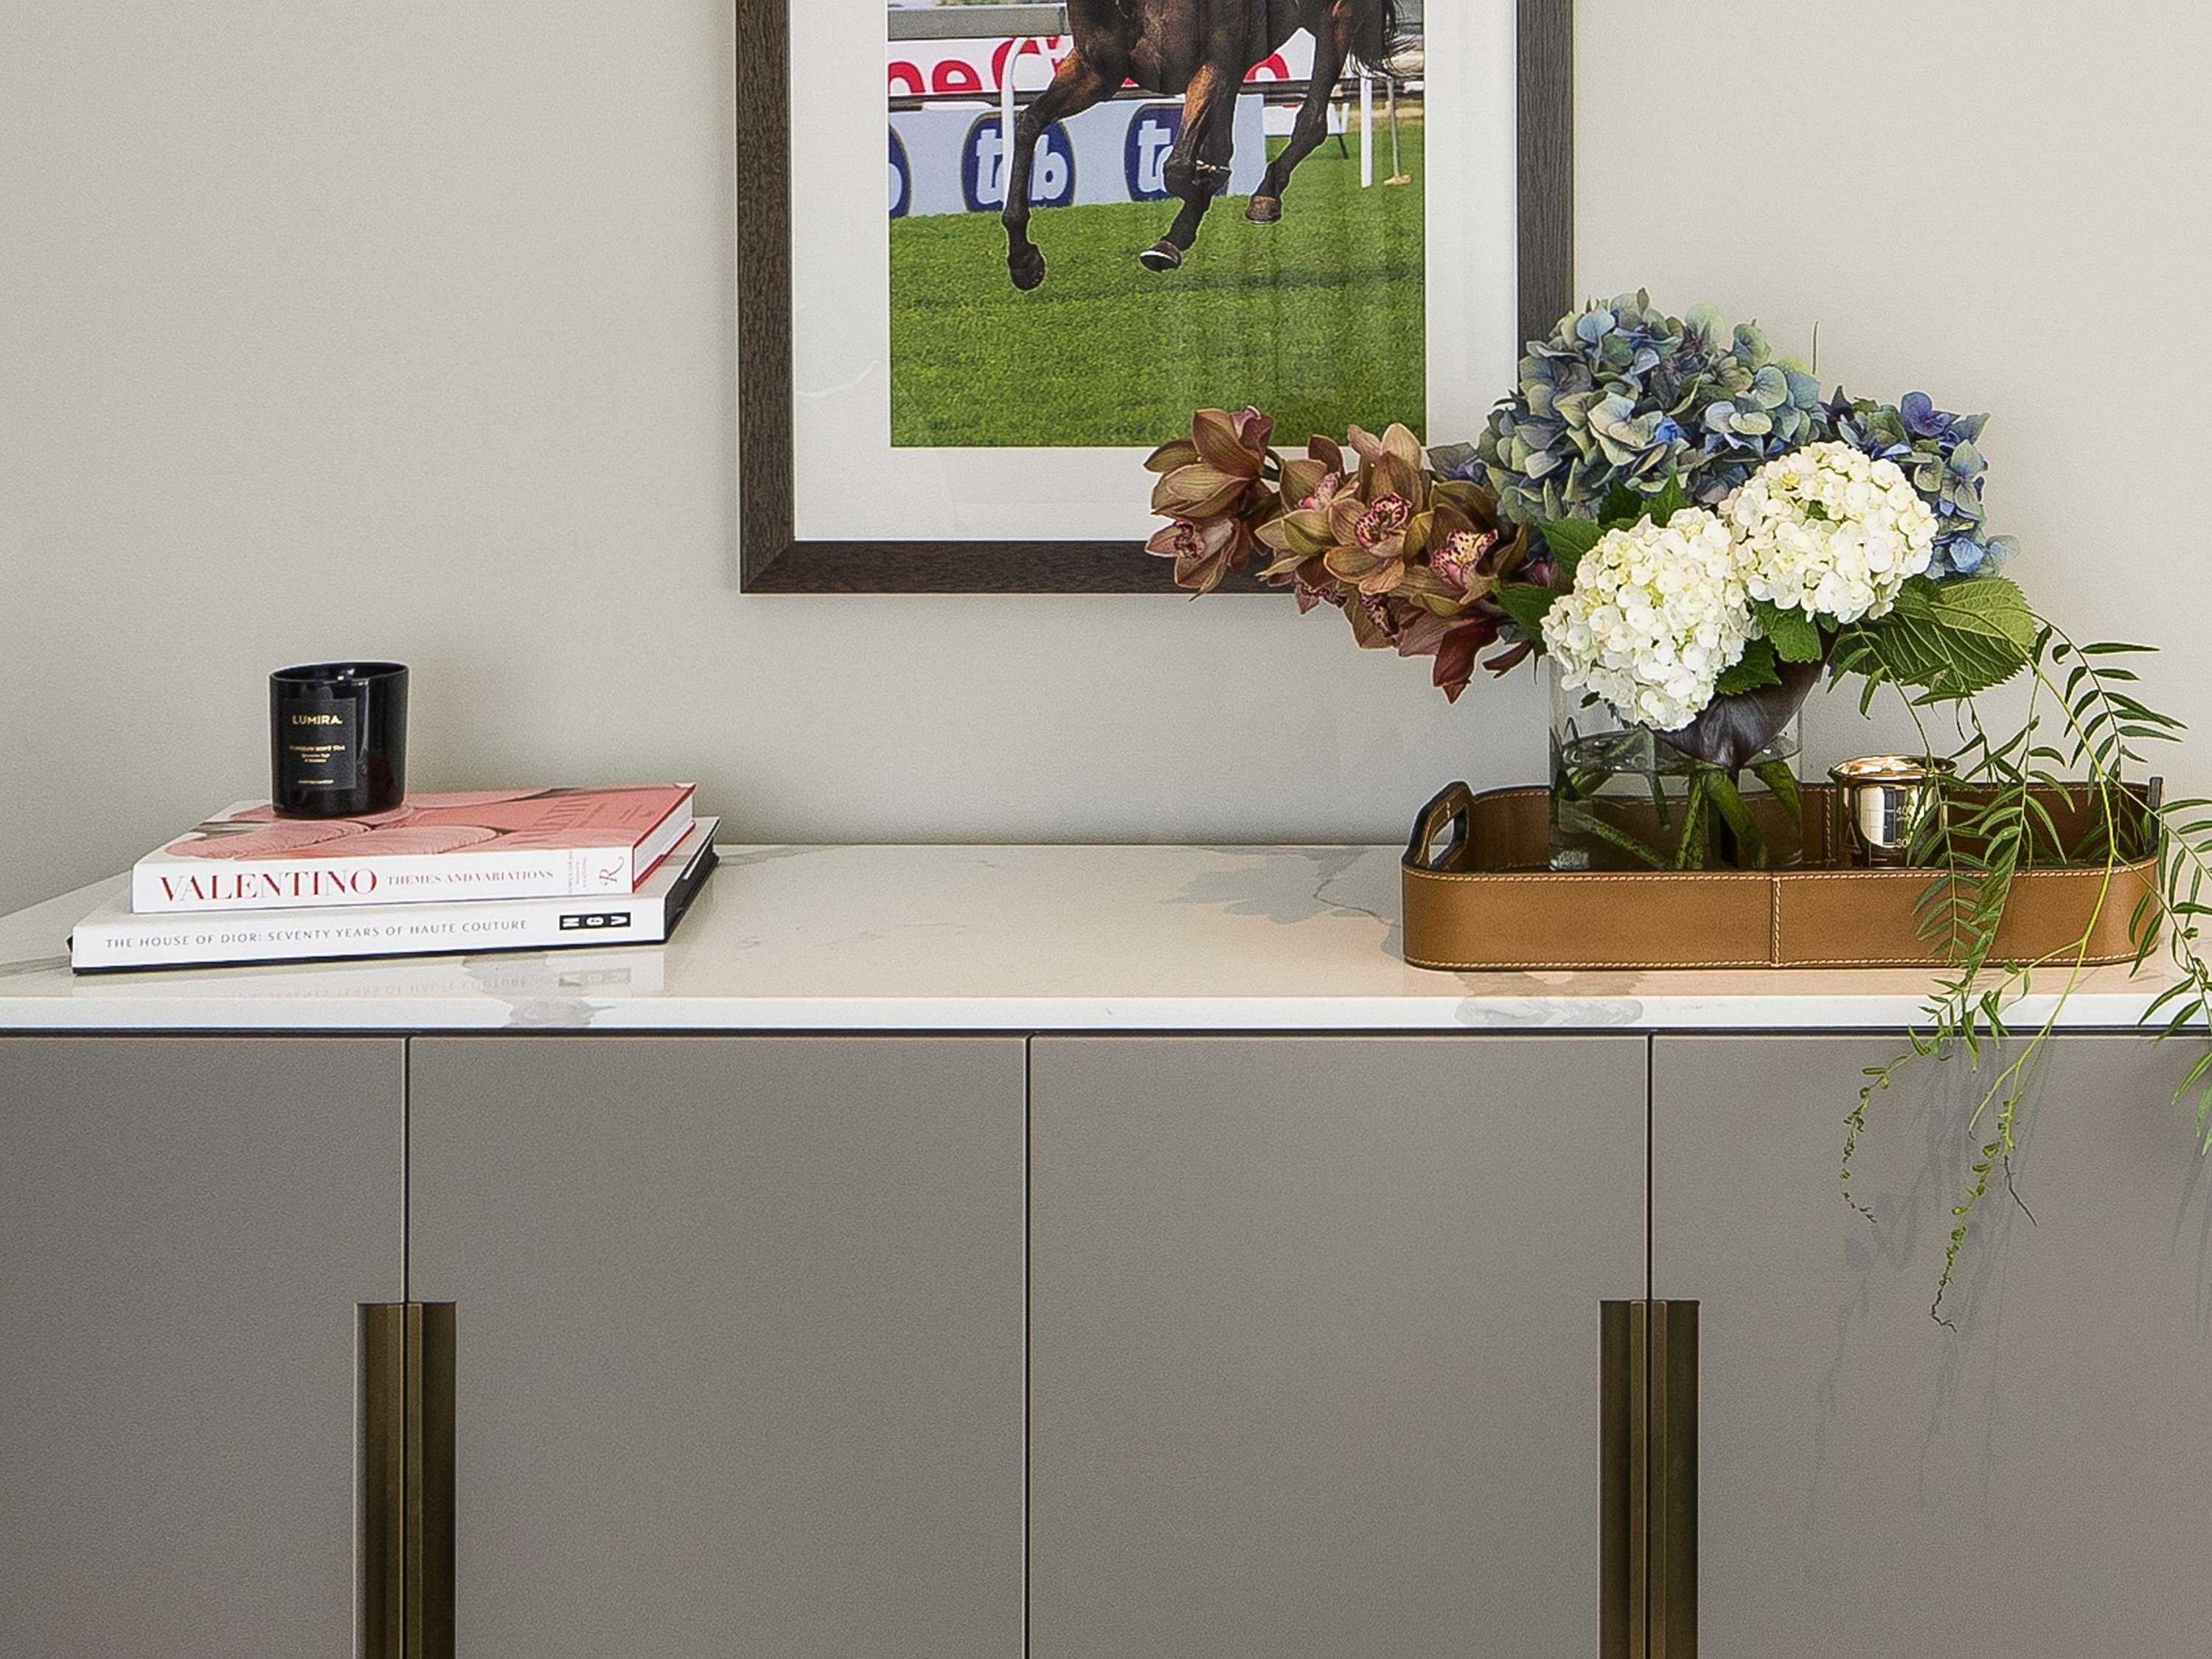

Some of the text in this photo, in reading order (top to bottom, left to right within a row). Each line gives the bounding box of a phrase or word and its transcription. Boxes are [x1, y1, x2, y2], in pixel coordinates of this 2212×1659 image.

[976, 128, 1068, 204] tb
[160, 868, 554, 902] VALENTINO THEMES AND VARIATIONS
[106, 920, 526, 948] THE HOUSE OF DIOR: SEVENTY YEARS OF HAUTE COUTURE
[563, 915, 627, 928] NGV
